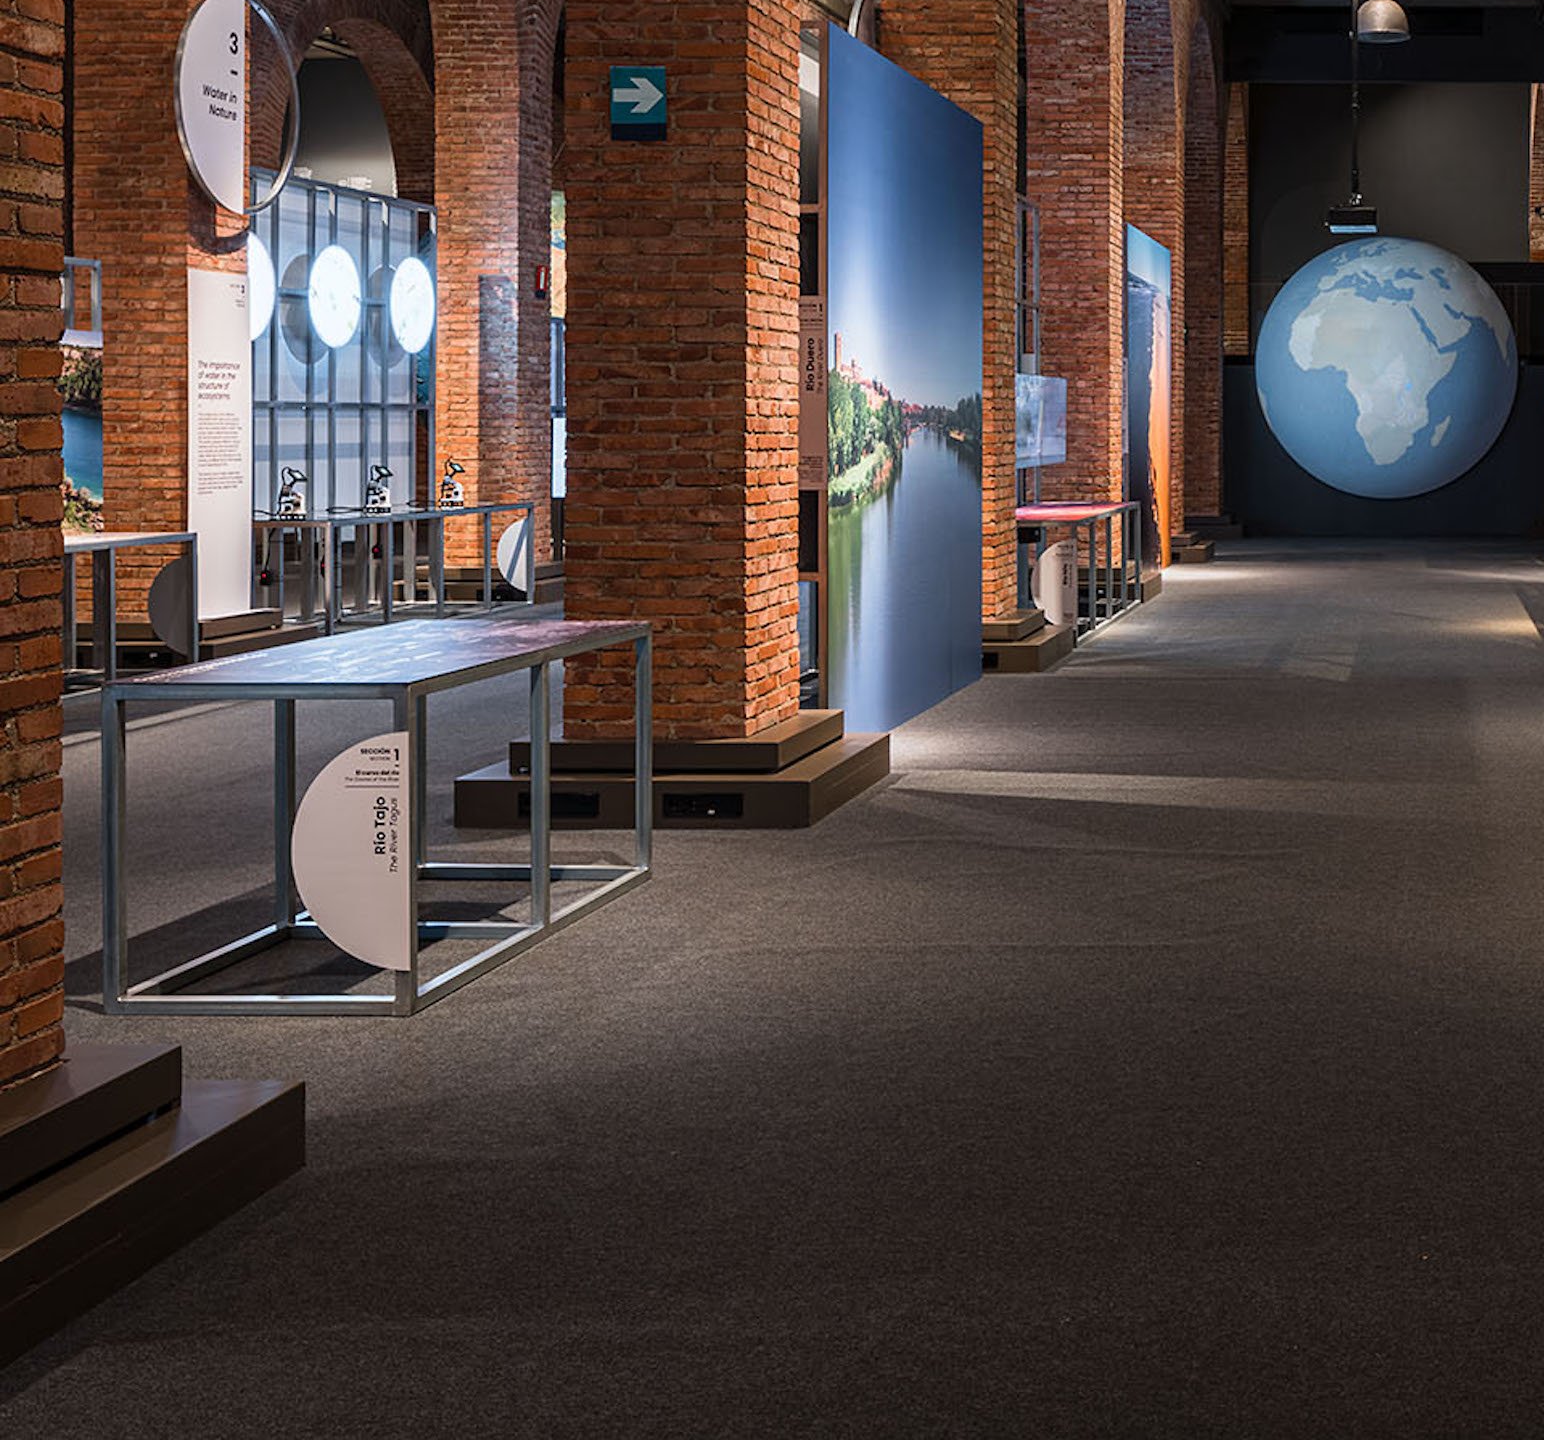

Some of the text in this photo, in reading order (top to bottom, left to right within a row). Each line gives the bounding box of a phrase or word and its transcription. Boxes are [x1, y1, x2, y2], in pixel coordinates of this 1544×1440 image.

[229, 31, 238, 55] 3
[202, 84, 238, 104] Water in
[208, 104, 237, 121] Nature
[805, 338, 815, 391] Río Duero
[394, 748, 399, 761] 1
[374, 796, 389, 855] Río Tajo
[390, 797, 400, 873] The River Tagus
